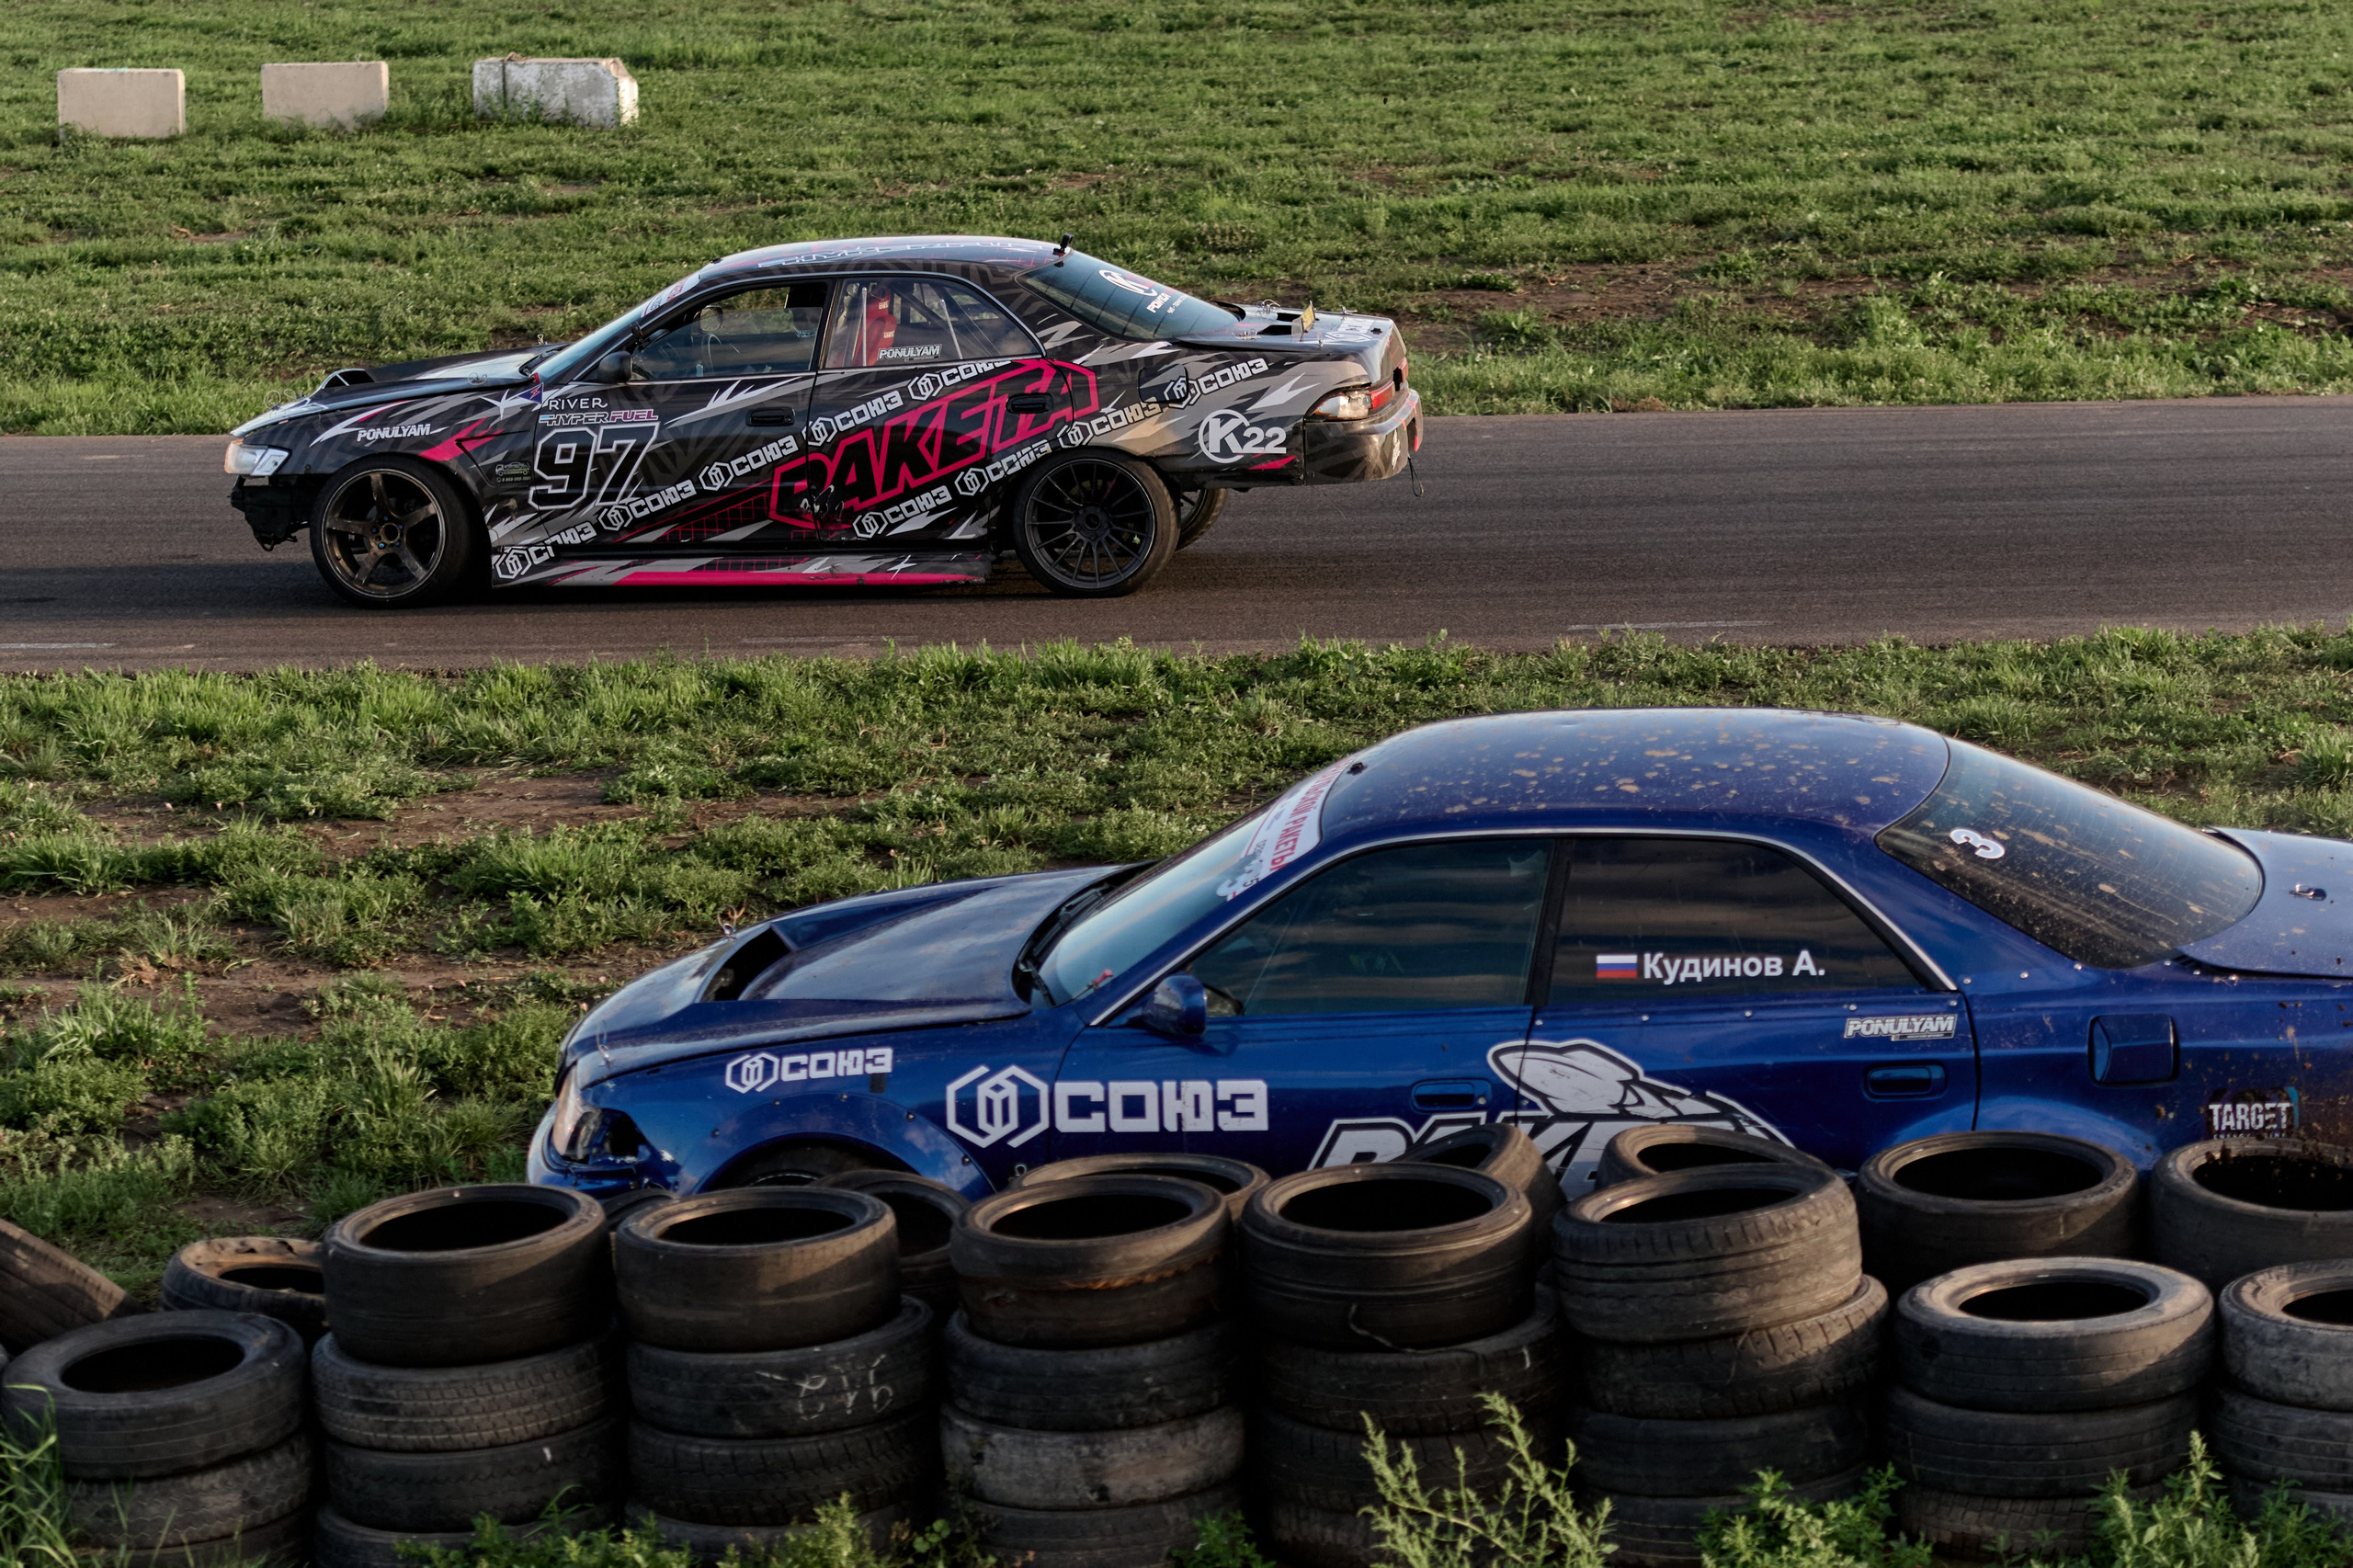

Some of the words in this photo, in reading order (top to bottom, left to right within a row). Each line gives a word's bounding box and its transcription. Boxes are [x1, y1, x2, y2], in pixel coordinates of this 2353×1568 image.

[879, 346, 941, 360] PONULYAM
[1199, 358, 1268, 395] СОЮЗ
[549, 397, 608, 411] RIVER
[835, 390, 904, 432] СОЮЗ
[1091, 396, 1162, 436] СОЮЗ
[357, 424, 431, 442] PONULYAM
[528, 421, 661, 510] 97
[732, 436, 800, 477] СОЮЗ
[988, 438, 1053, 483] СОЮЗ
[630, 479, 697, 518] СОЮЗ
[884, 484, 953, 525] СОЮЗ
[1643, 952, 1783, 985] Кудинов
[1792, 949, 1826, 977] А.
[1847, 1016, 1955, 1038] PONULYAM
[780, 1047, 893, 1081] СОЮЗ
[1054, 1080, 1268, 1132] СОЮЗ
[2208, 1102, 2291, 1131] TARGET
